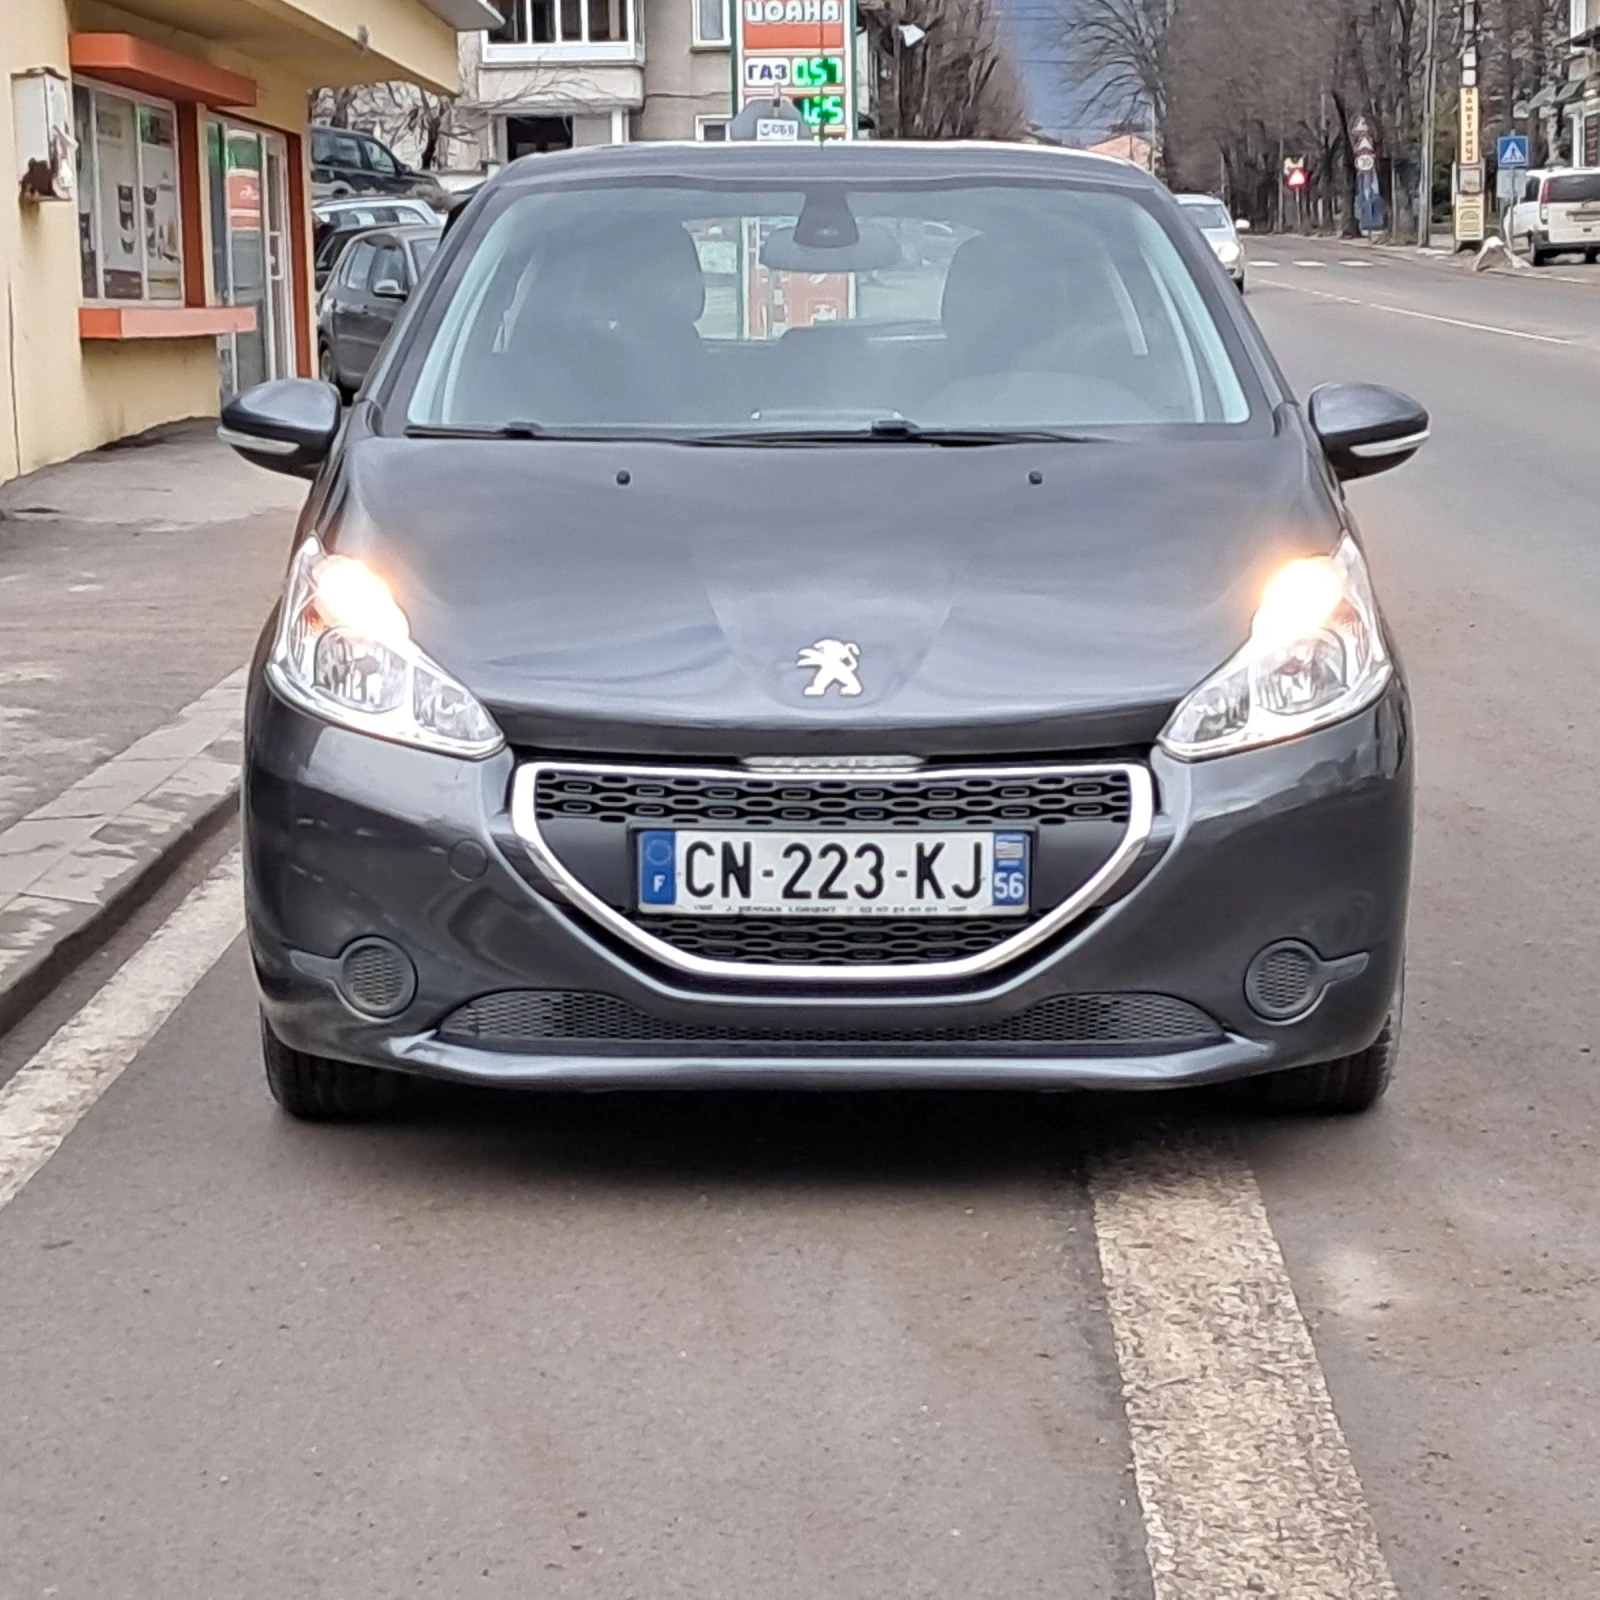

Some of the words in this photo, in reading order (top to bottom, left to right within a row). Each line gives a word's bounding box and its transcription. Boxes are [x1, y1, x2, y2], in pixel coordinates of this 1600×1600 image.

[748, 64, 788, 80] ГАЗ
[685, 841, 982, 899] CN-223-KJ
[653, 875, 666, 893] F
[994, 871, 1024, 899] 56
